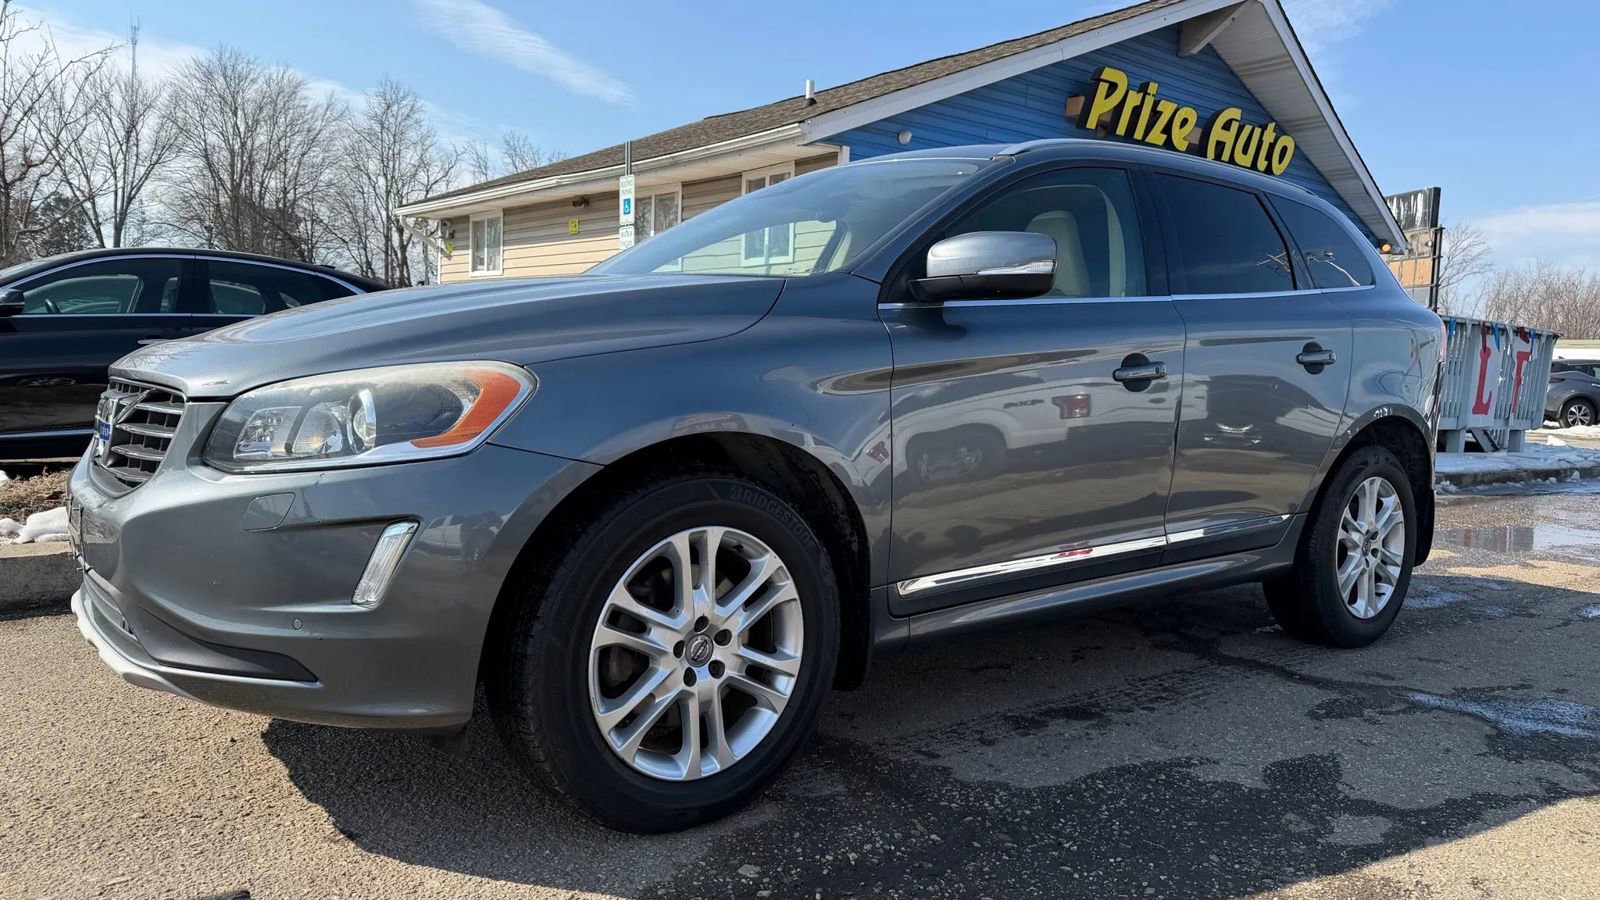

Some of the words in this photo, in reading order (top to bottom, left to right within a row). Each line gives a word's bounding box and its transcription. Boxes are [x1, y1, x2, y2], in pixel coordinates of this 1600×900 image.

[1085, 67, 1197, 152] Prize
[1207, 107, 1295, 175] Auto
[729, 485, 817, 551] BRIDGESTONE
